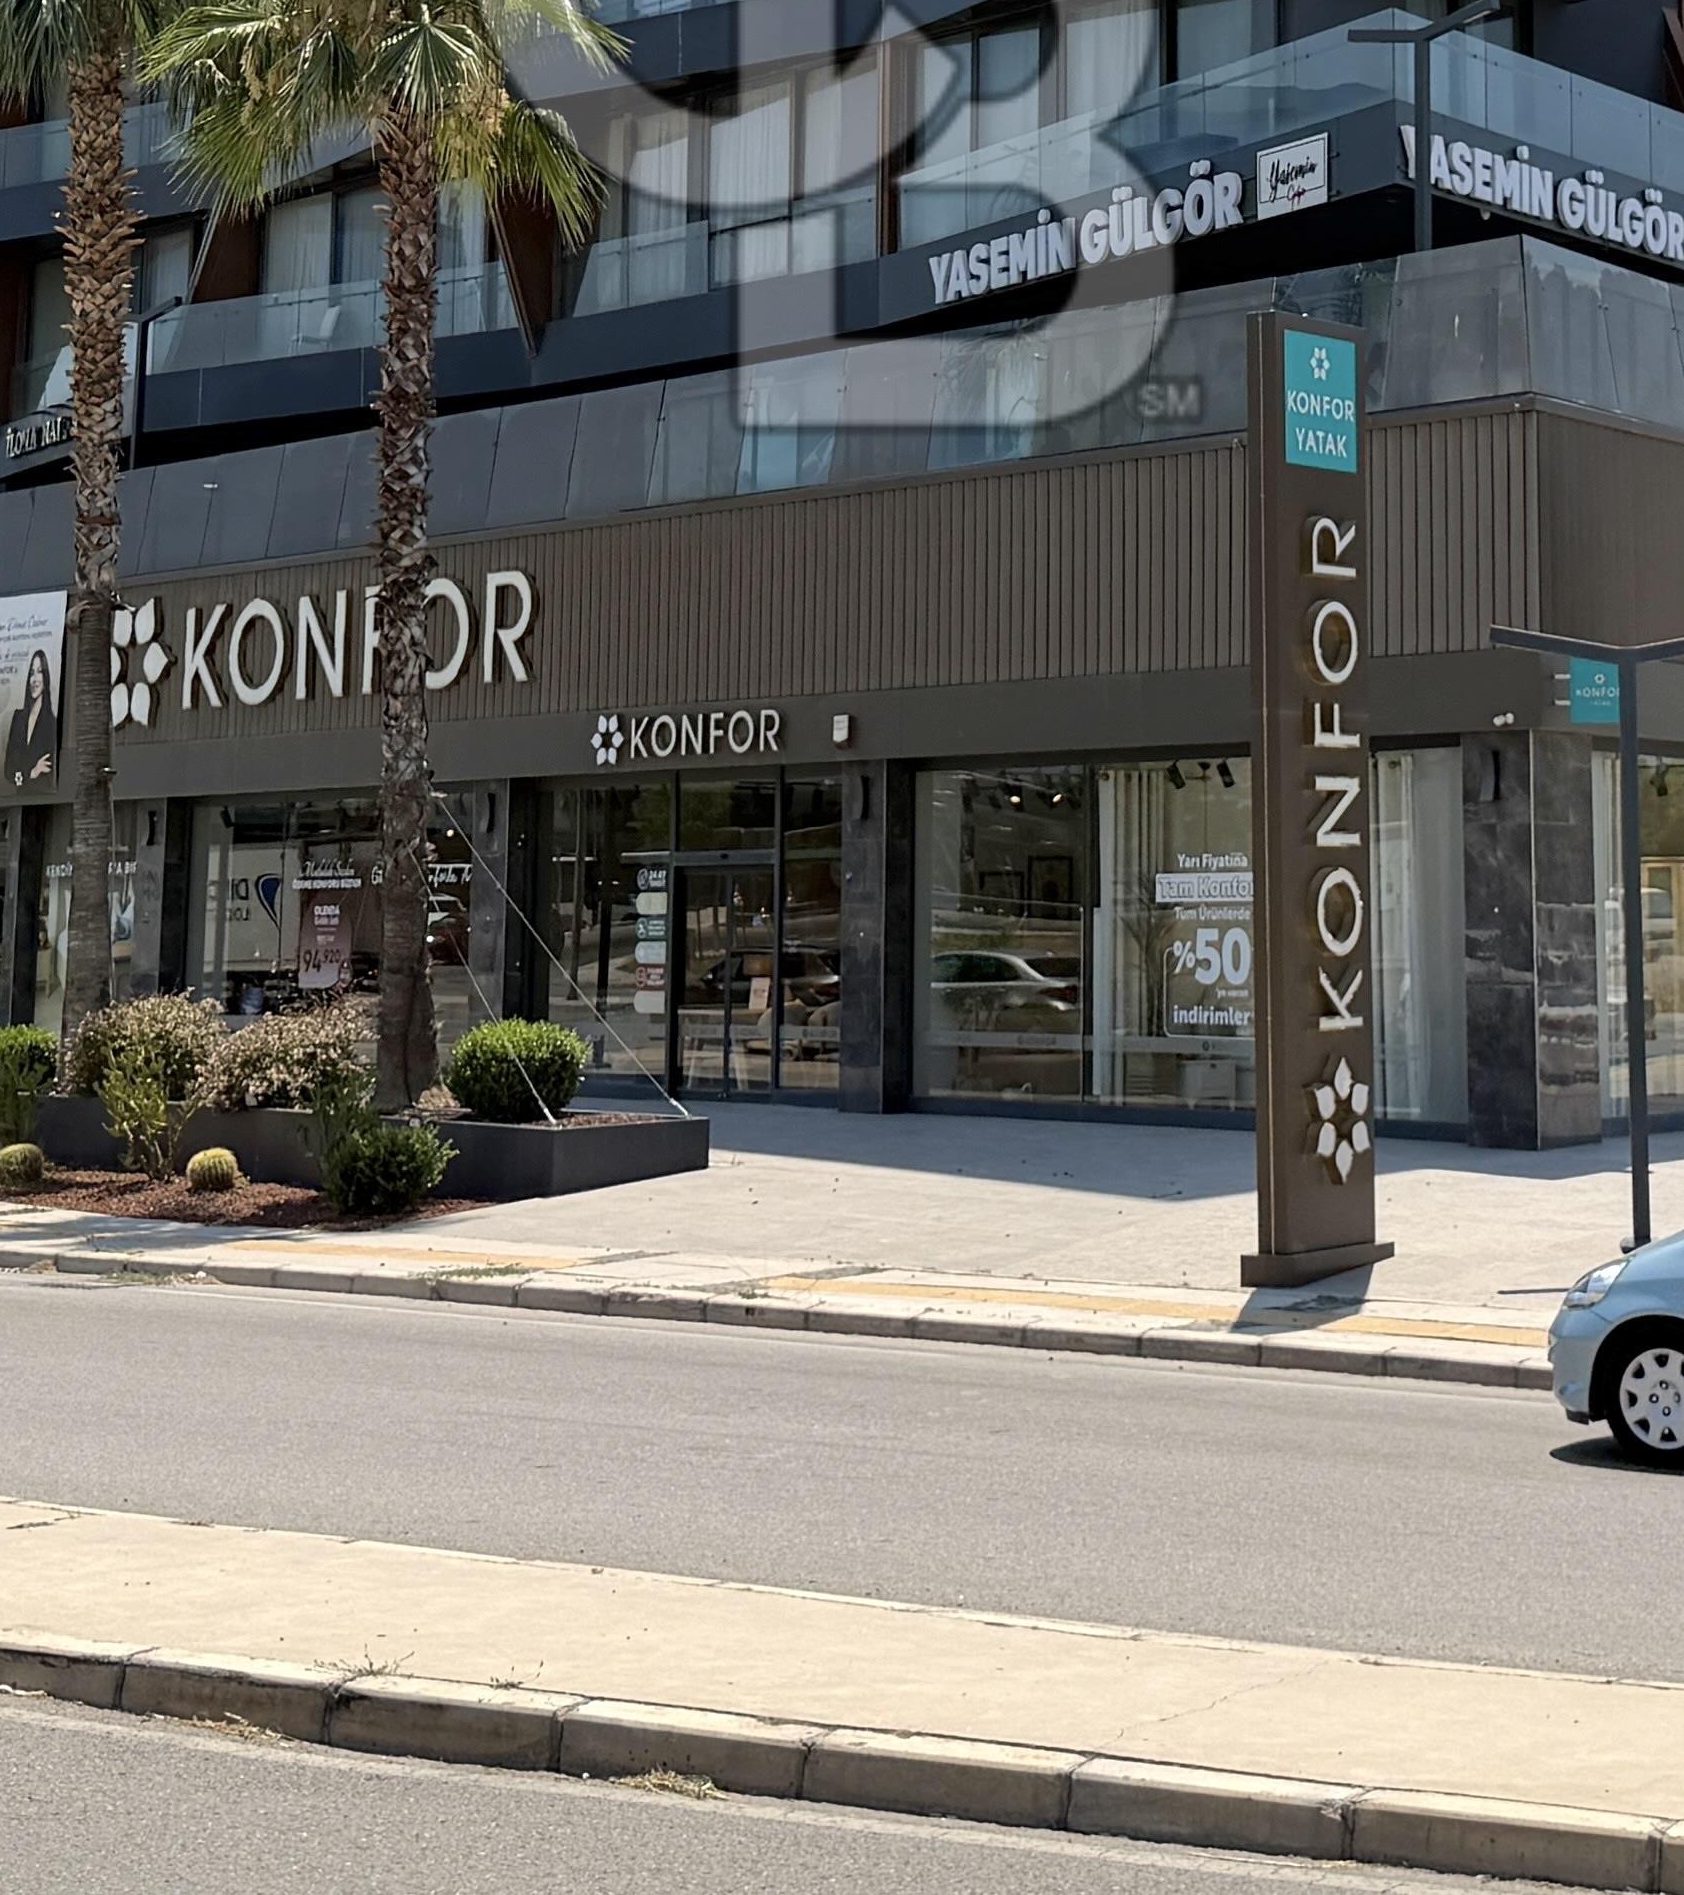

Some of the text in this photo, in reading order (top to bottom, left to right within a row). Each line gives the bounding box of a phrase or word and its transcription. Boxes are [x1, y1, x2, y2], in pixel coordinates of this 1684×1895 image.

[929, 160, 1244, 304] YASEMİN GÜLGÖR
[1287, 391, 1355, 423] KONFOR
[1295, 426, 1348, 459] YATAK
[182, 570, 532, 710] KONFOR
[630, 708, 781, 759] KONFOR
[1312, 515, 1364, 1031] KONFOR
[1177, 852, 1248, 871] Yarı Fiyatına
[1159, 878, 1194, 898] Tam
[1173, 927, 1252, 985] %50
[1173, 1005, 1251, 1026] indirimler
